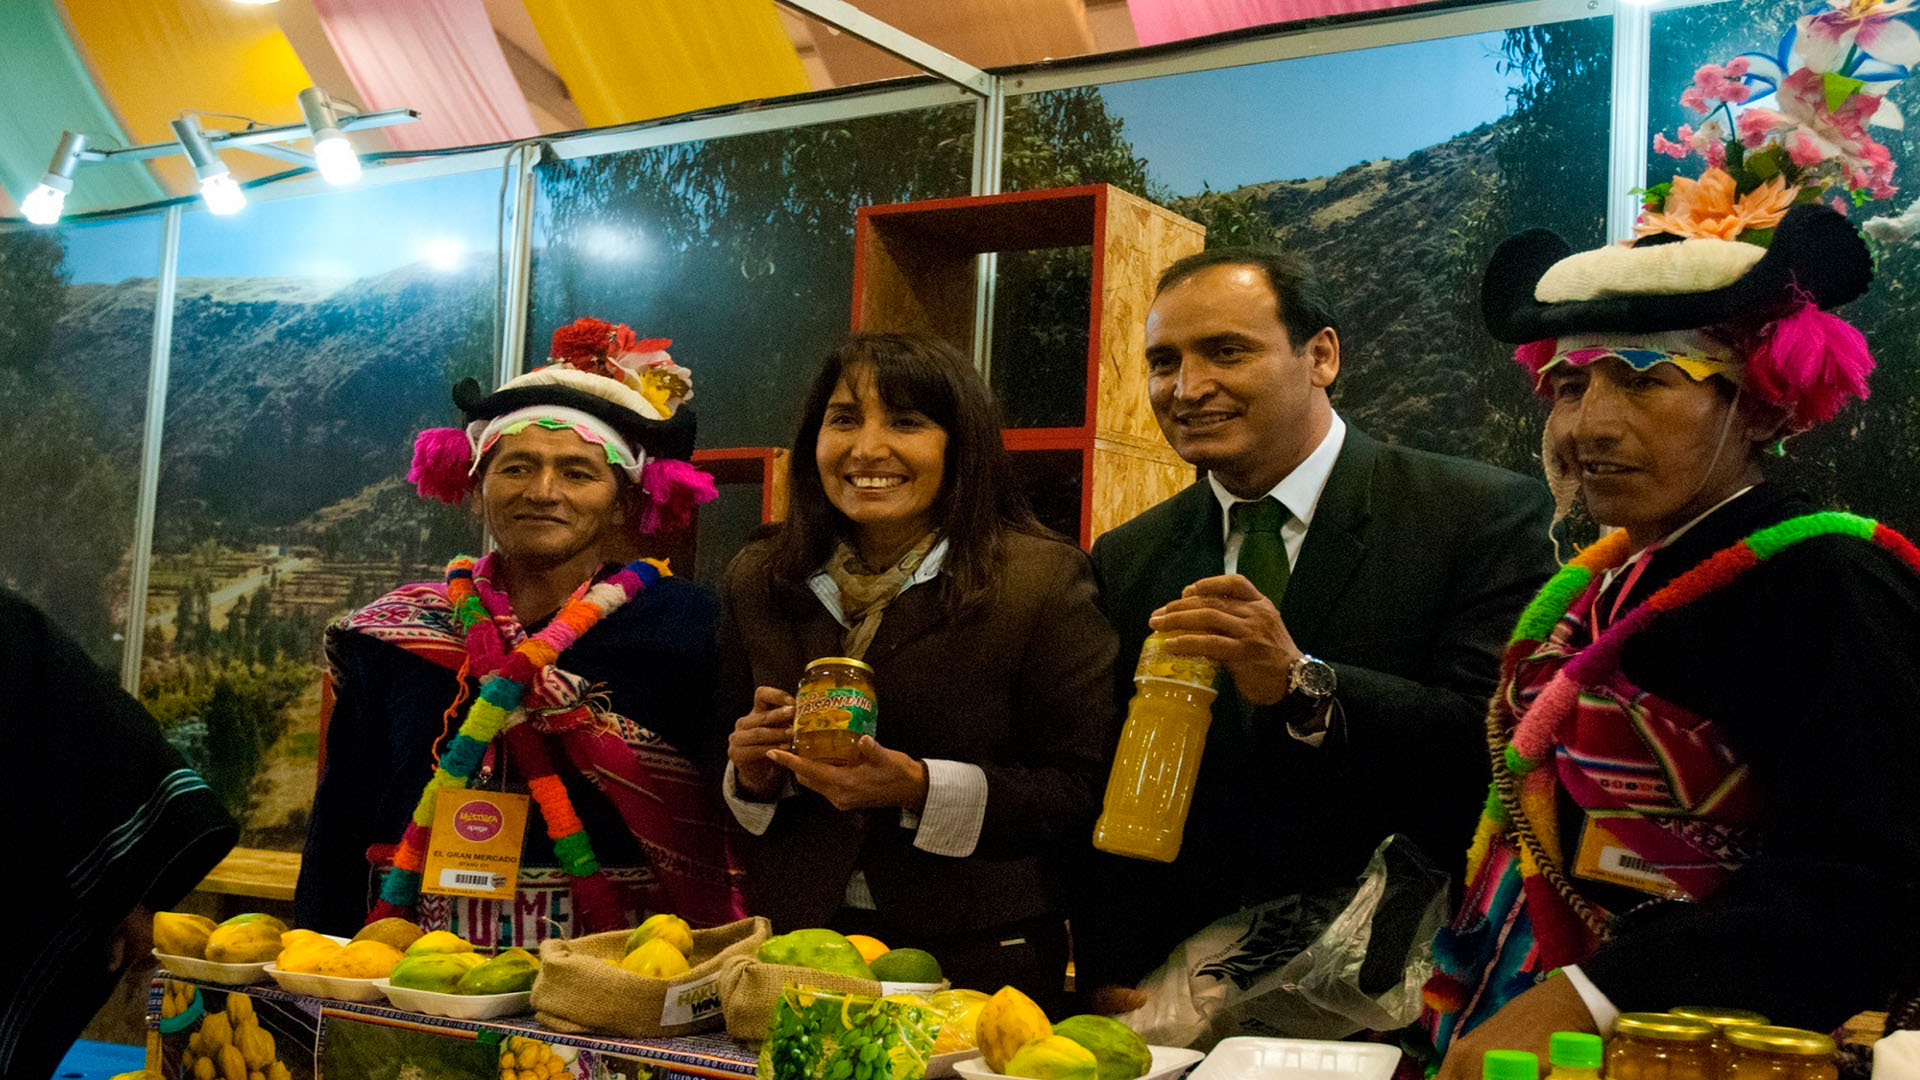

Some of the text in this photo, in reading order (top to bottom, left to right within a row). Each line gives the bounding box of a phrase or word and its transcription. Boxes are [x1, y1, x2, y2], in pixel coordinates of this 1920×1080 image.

[433, 850, 518, 863] EL GRAN MERCADO
[677, 982, 719, 1007] HAKU
